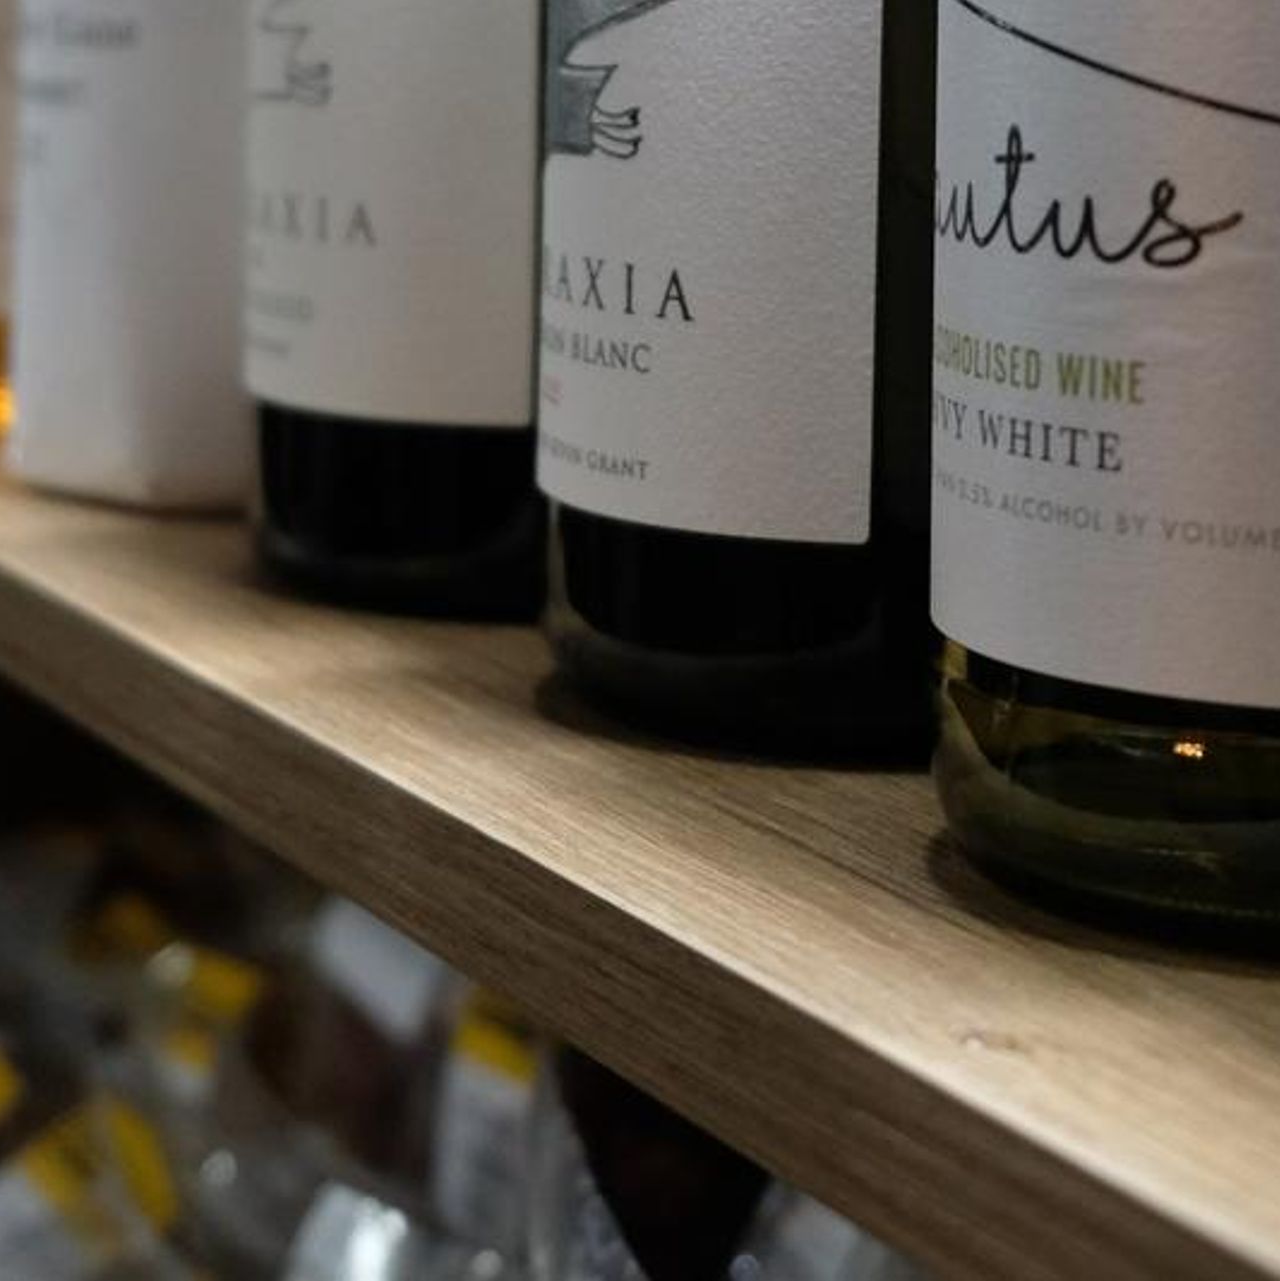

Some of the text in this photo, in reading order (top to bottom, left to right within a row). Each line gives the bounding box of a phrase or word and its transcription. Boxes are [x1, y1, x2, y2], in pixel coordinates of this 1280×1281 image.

[935, 122, 1245, 269] utus
[571, 332, 654, 374] BLANC
[1055, 351, 1147, 407] WINE
[977, 409, 1125, 473] WHITE
[998, 493, 1103, 534] ALCOHOL
[1114, 510, 1148, 536] BY
